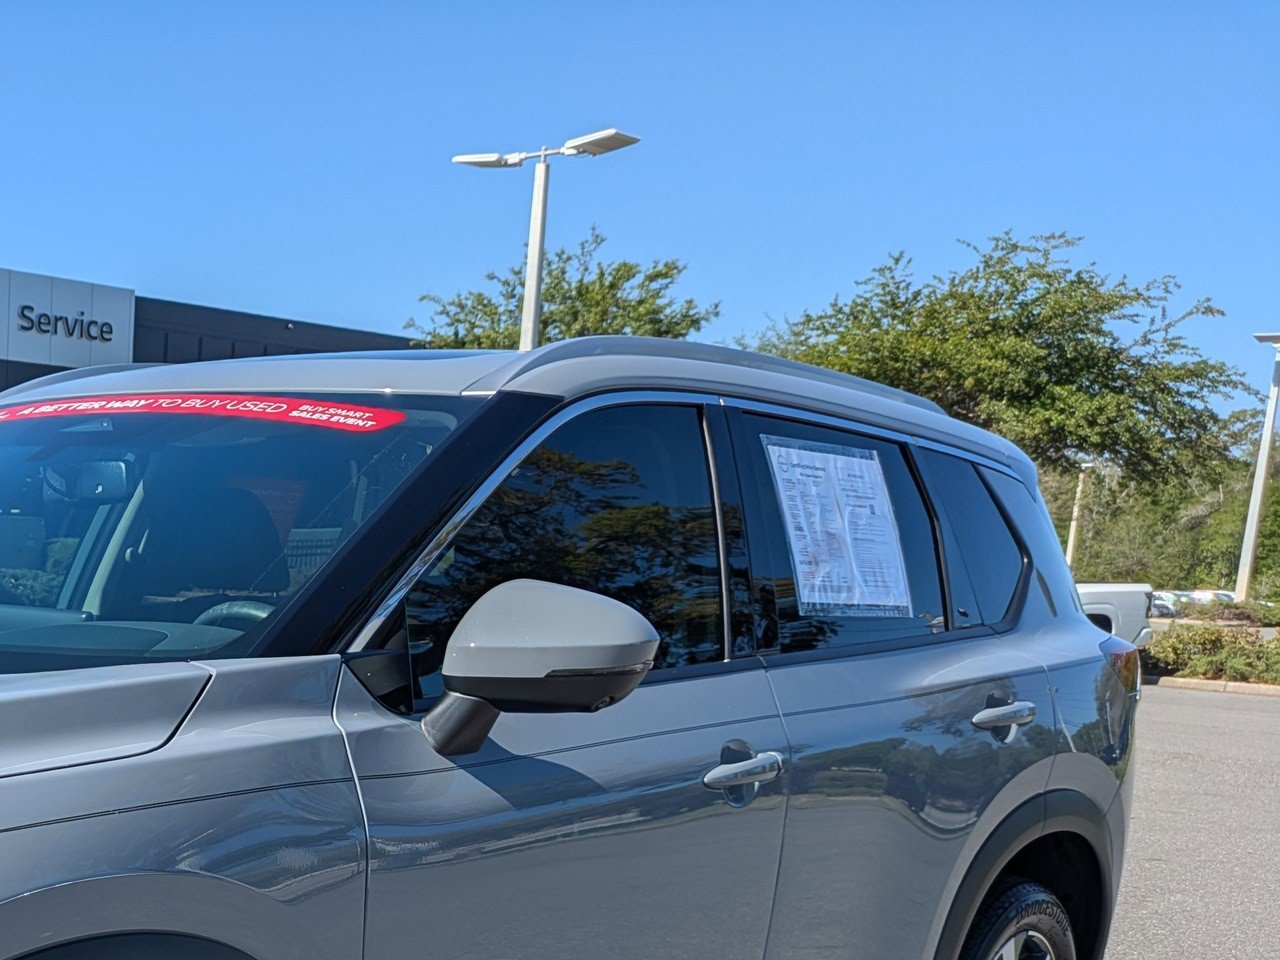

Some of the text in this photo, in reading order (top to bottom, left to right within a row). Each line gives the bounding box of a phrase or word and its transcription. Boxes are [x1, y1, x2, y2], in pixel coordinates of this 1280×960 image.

[18, 304, 114, 342] Service
[16, 398, 288, 416] A BETTER WAY TO BUY USED
[298, 404, 374, 419] BUY SMART
[288, 410, 378, 428] SALES EVENT
[1013, 899, 1068, 938] BRIDGESTONE
